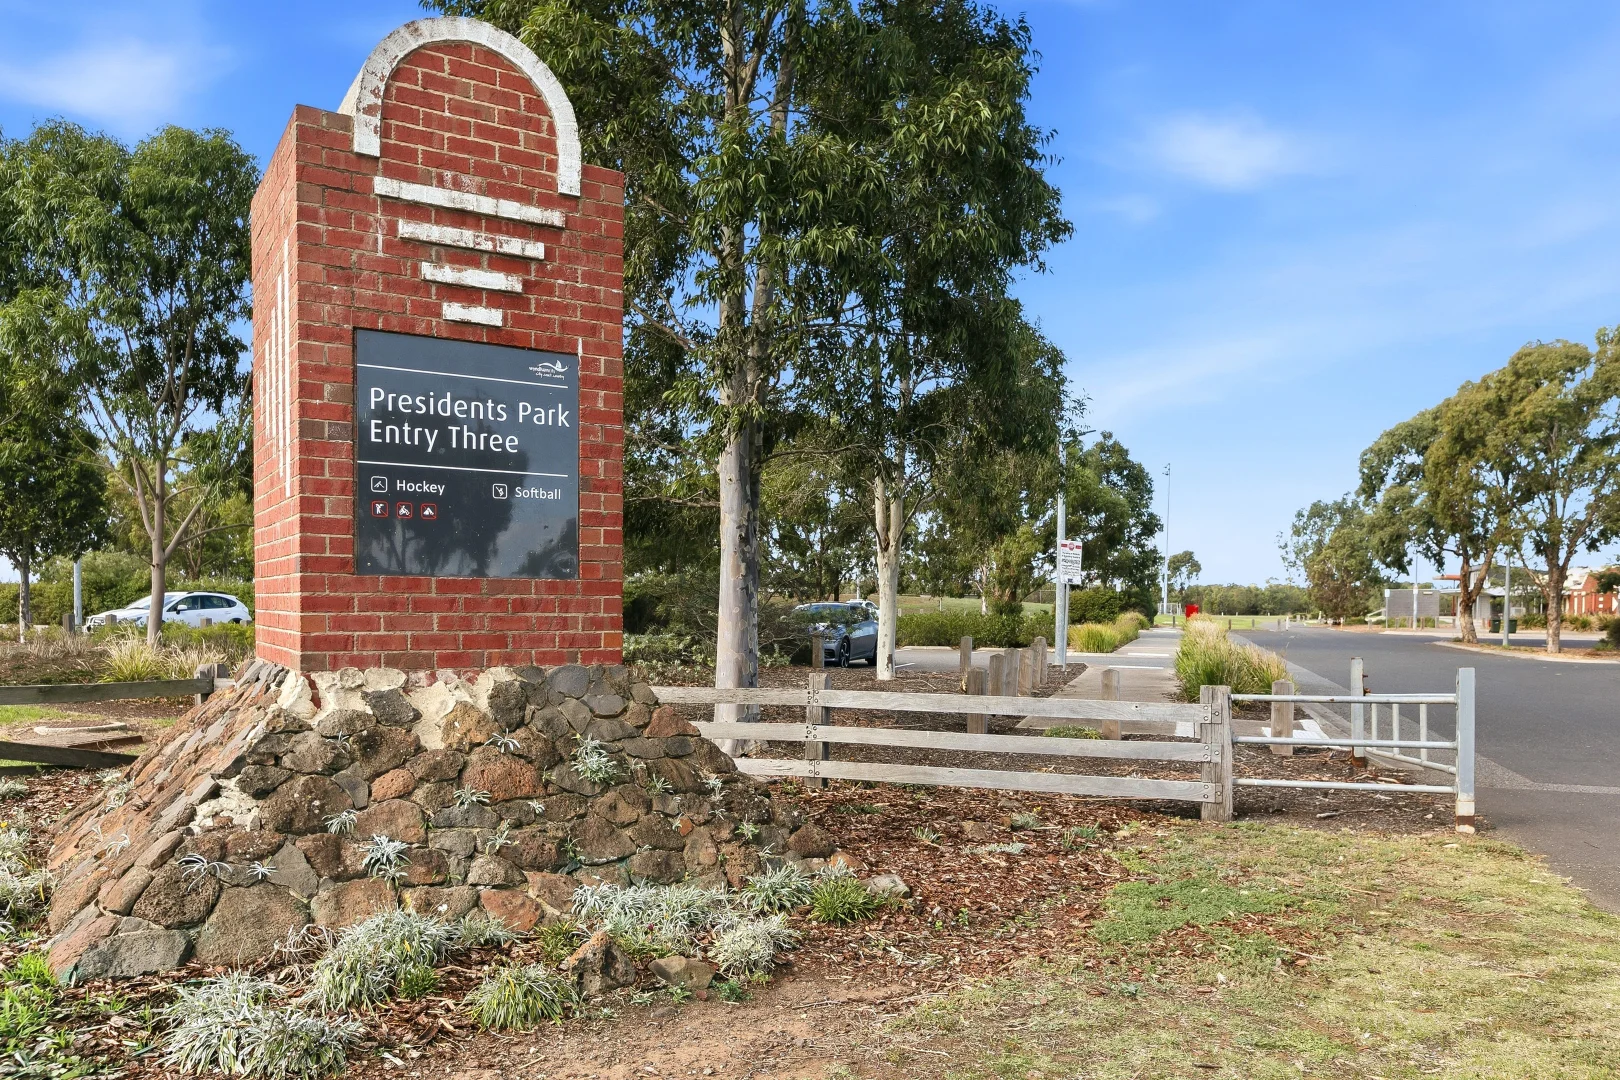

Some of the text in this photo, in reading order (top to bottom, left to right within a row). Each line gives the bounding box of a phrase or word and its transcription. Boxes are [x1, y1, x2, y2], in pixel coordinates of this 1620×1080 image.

[370, 387, 570, 428] Presidents Park
[370, 420, 519, 453] Entry Three
[396, 479, 445, 496] Hockey
[515, 486, 561, 500] Softball
